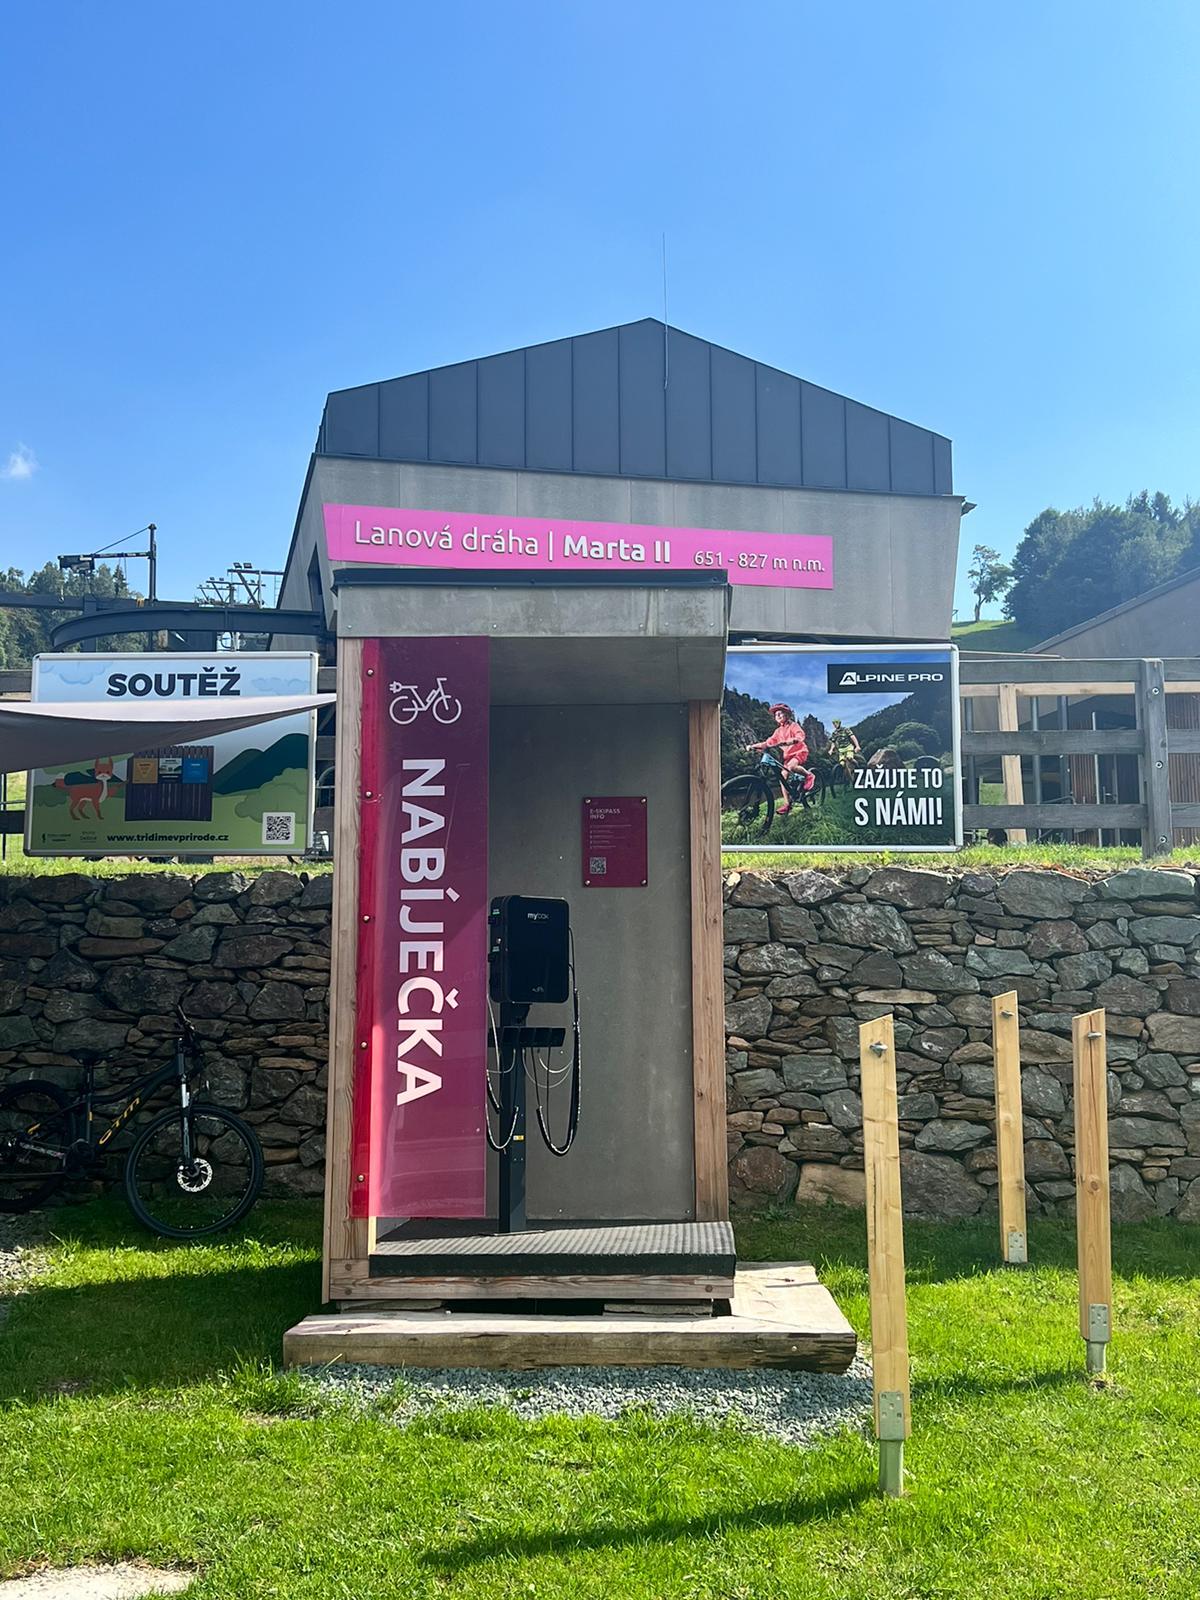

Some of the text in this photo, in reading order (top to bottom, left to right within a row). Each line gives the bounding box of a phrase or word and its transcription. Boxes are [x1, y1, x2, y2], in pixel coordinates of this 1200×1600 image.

[355, 520, 453, 550] Lanová
[461, 526, 539, 555] dráha
[563, 535, 646, 562] Marta
[653, 540, 671, 563] II
[694, 550, 723, 567] 651
[738, 553, 769, 569] 827
[772, 557, 788, 570] m
[792, 558, 825, 573] n.m.
[106, 666, 241, 697] SOUTĚŽ
[839, 672, 944, 686] ALPINE PRO
[854, 763, 943, 789] ZAŽIJTE TO
[854, 790, 943, 826] S NÁMI!
[106, 833, 229, 843] www.tridimevprirode.cz
[527, 912, 550, 920] mybox
[397, 758, 460, 1106] NABÍJEČKA
